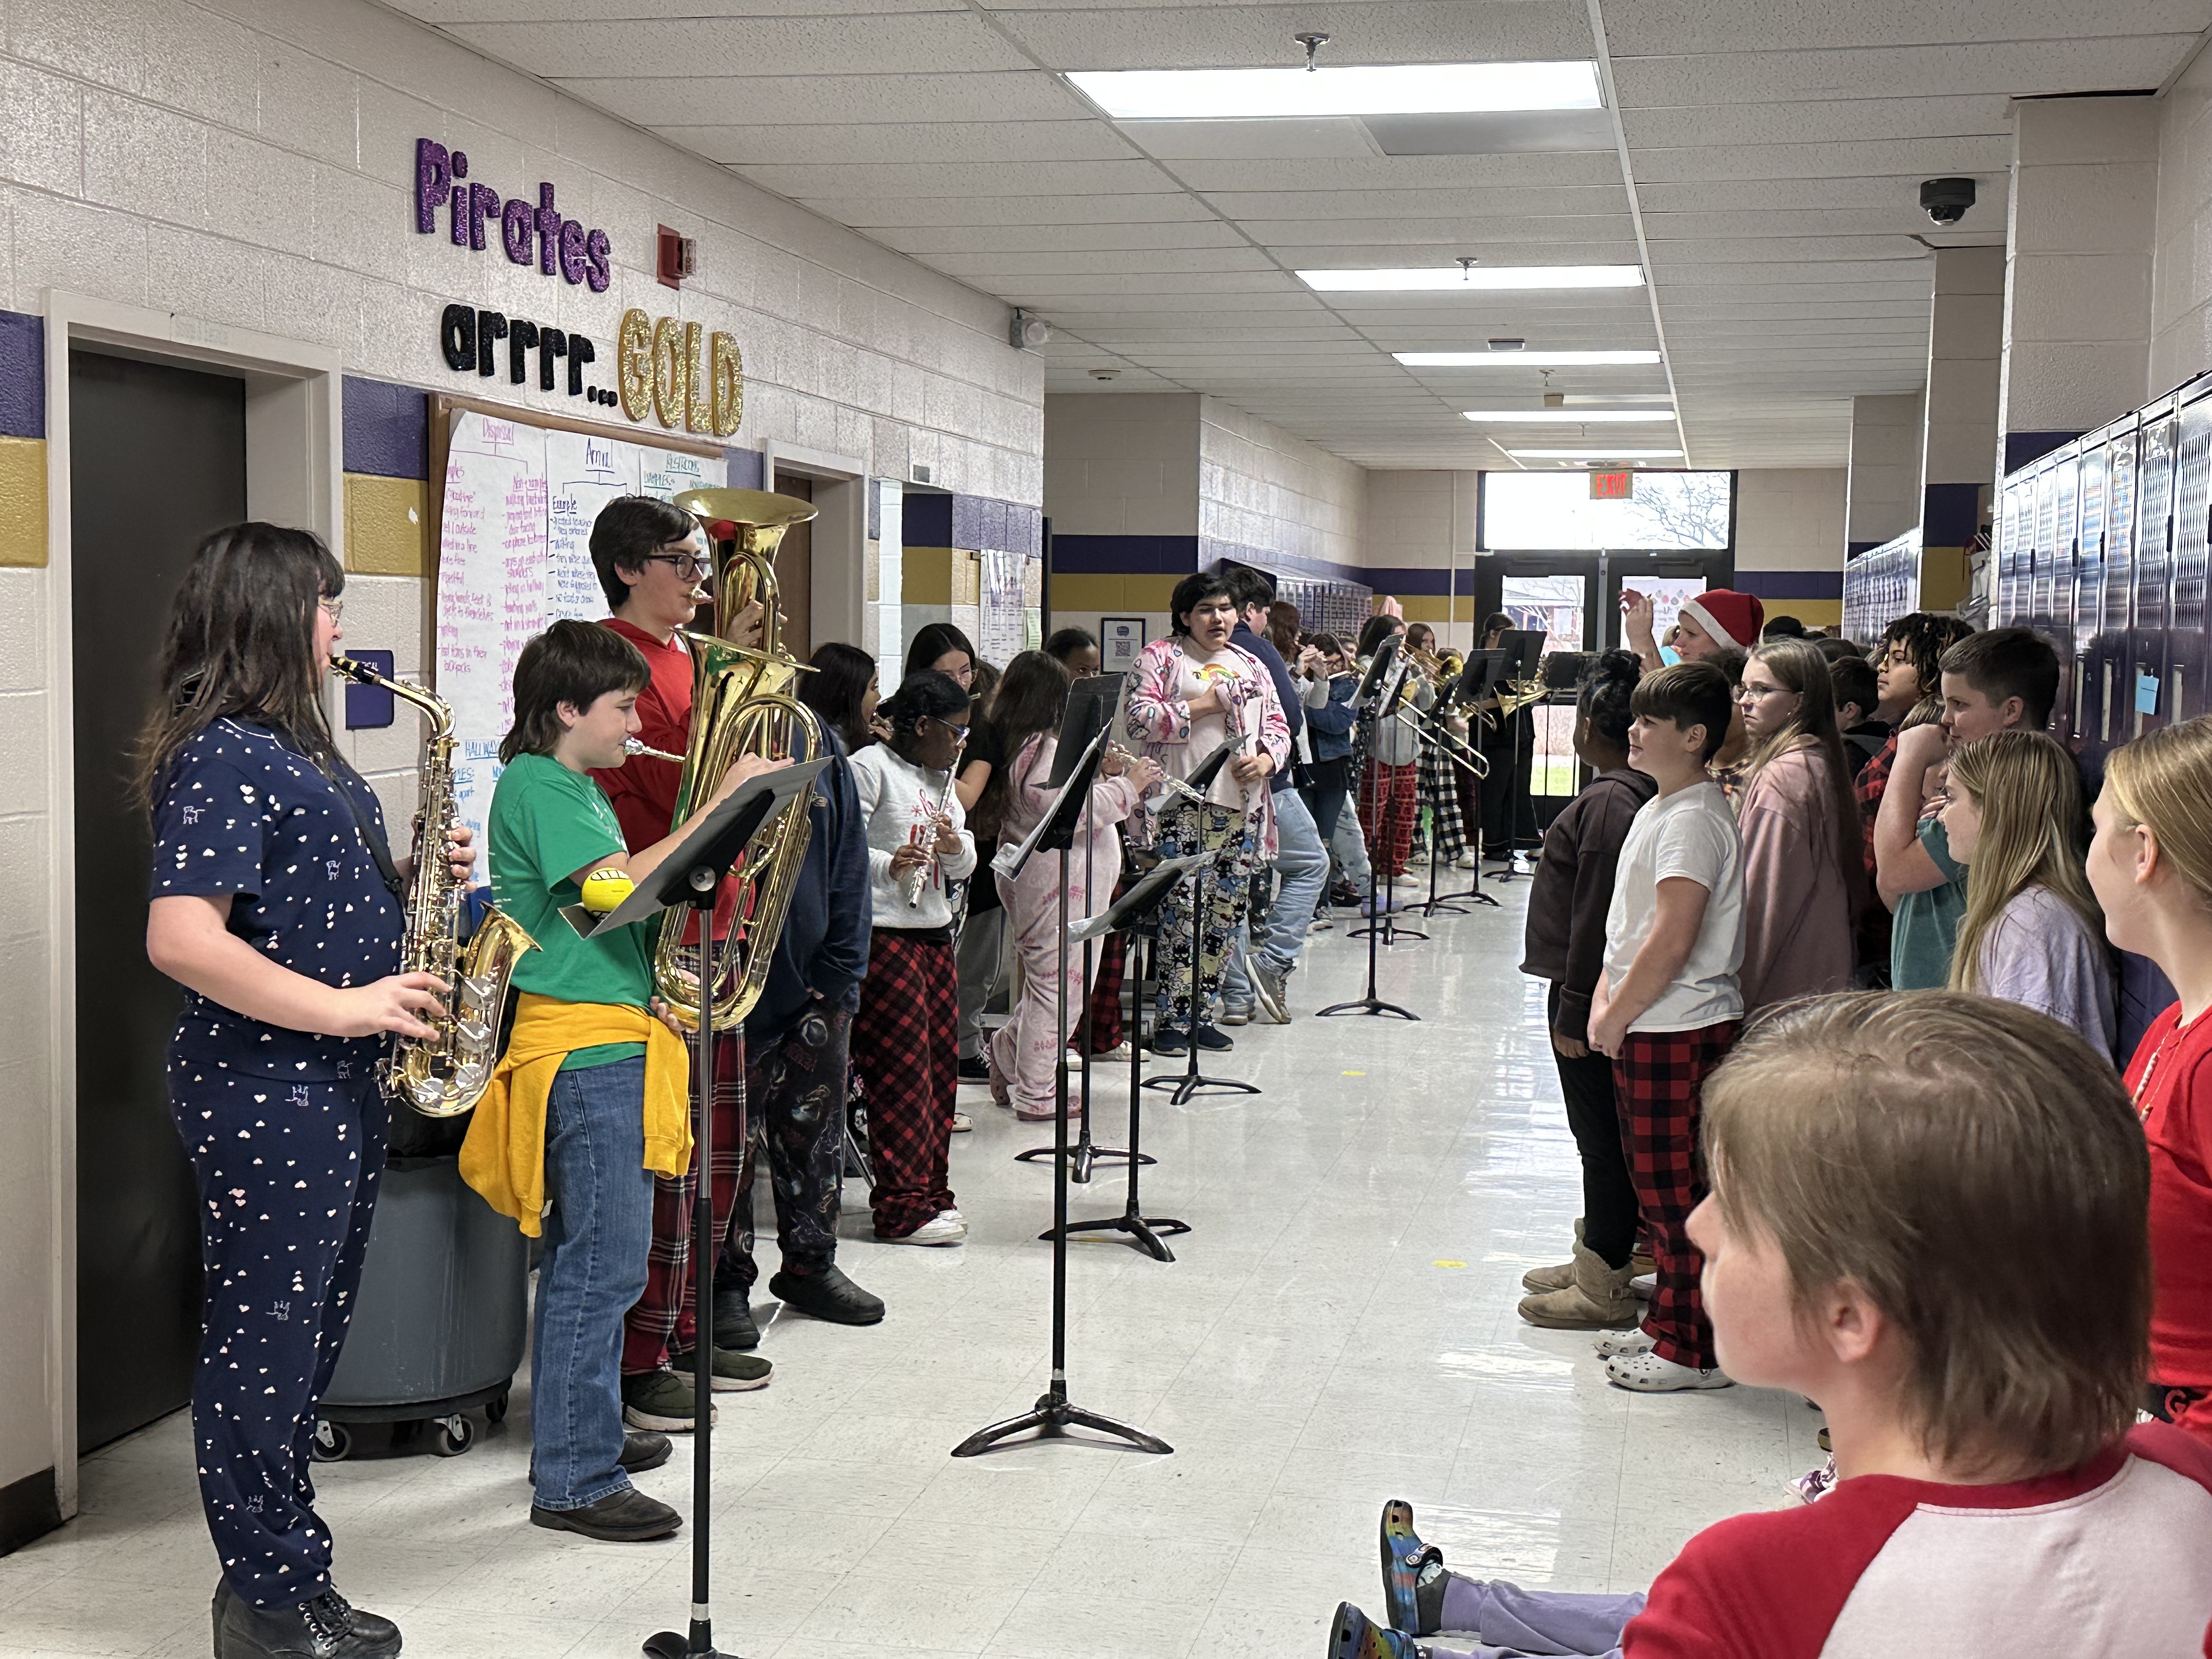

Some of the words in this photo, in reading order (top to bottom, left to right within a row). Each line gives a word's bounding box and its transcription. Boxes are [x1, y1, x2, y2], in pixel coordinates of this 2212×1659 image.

[416, 138, 611, 292] Pirates
[618, 308, 743, 437] GOLD
[1596, 472, 1628, 496] EXIT
